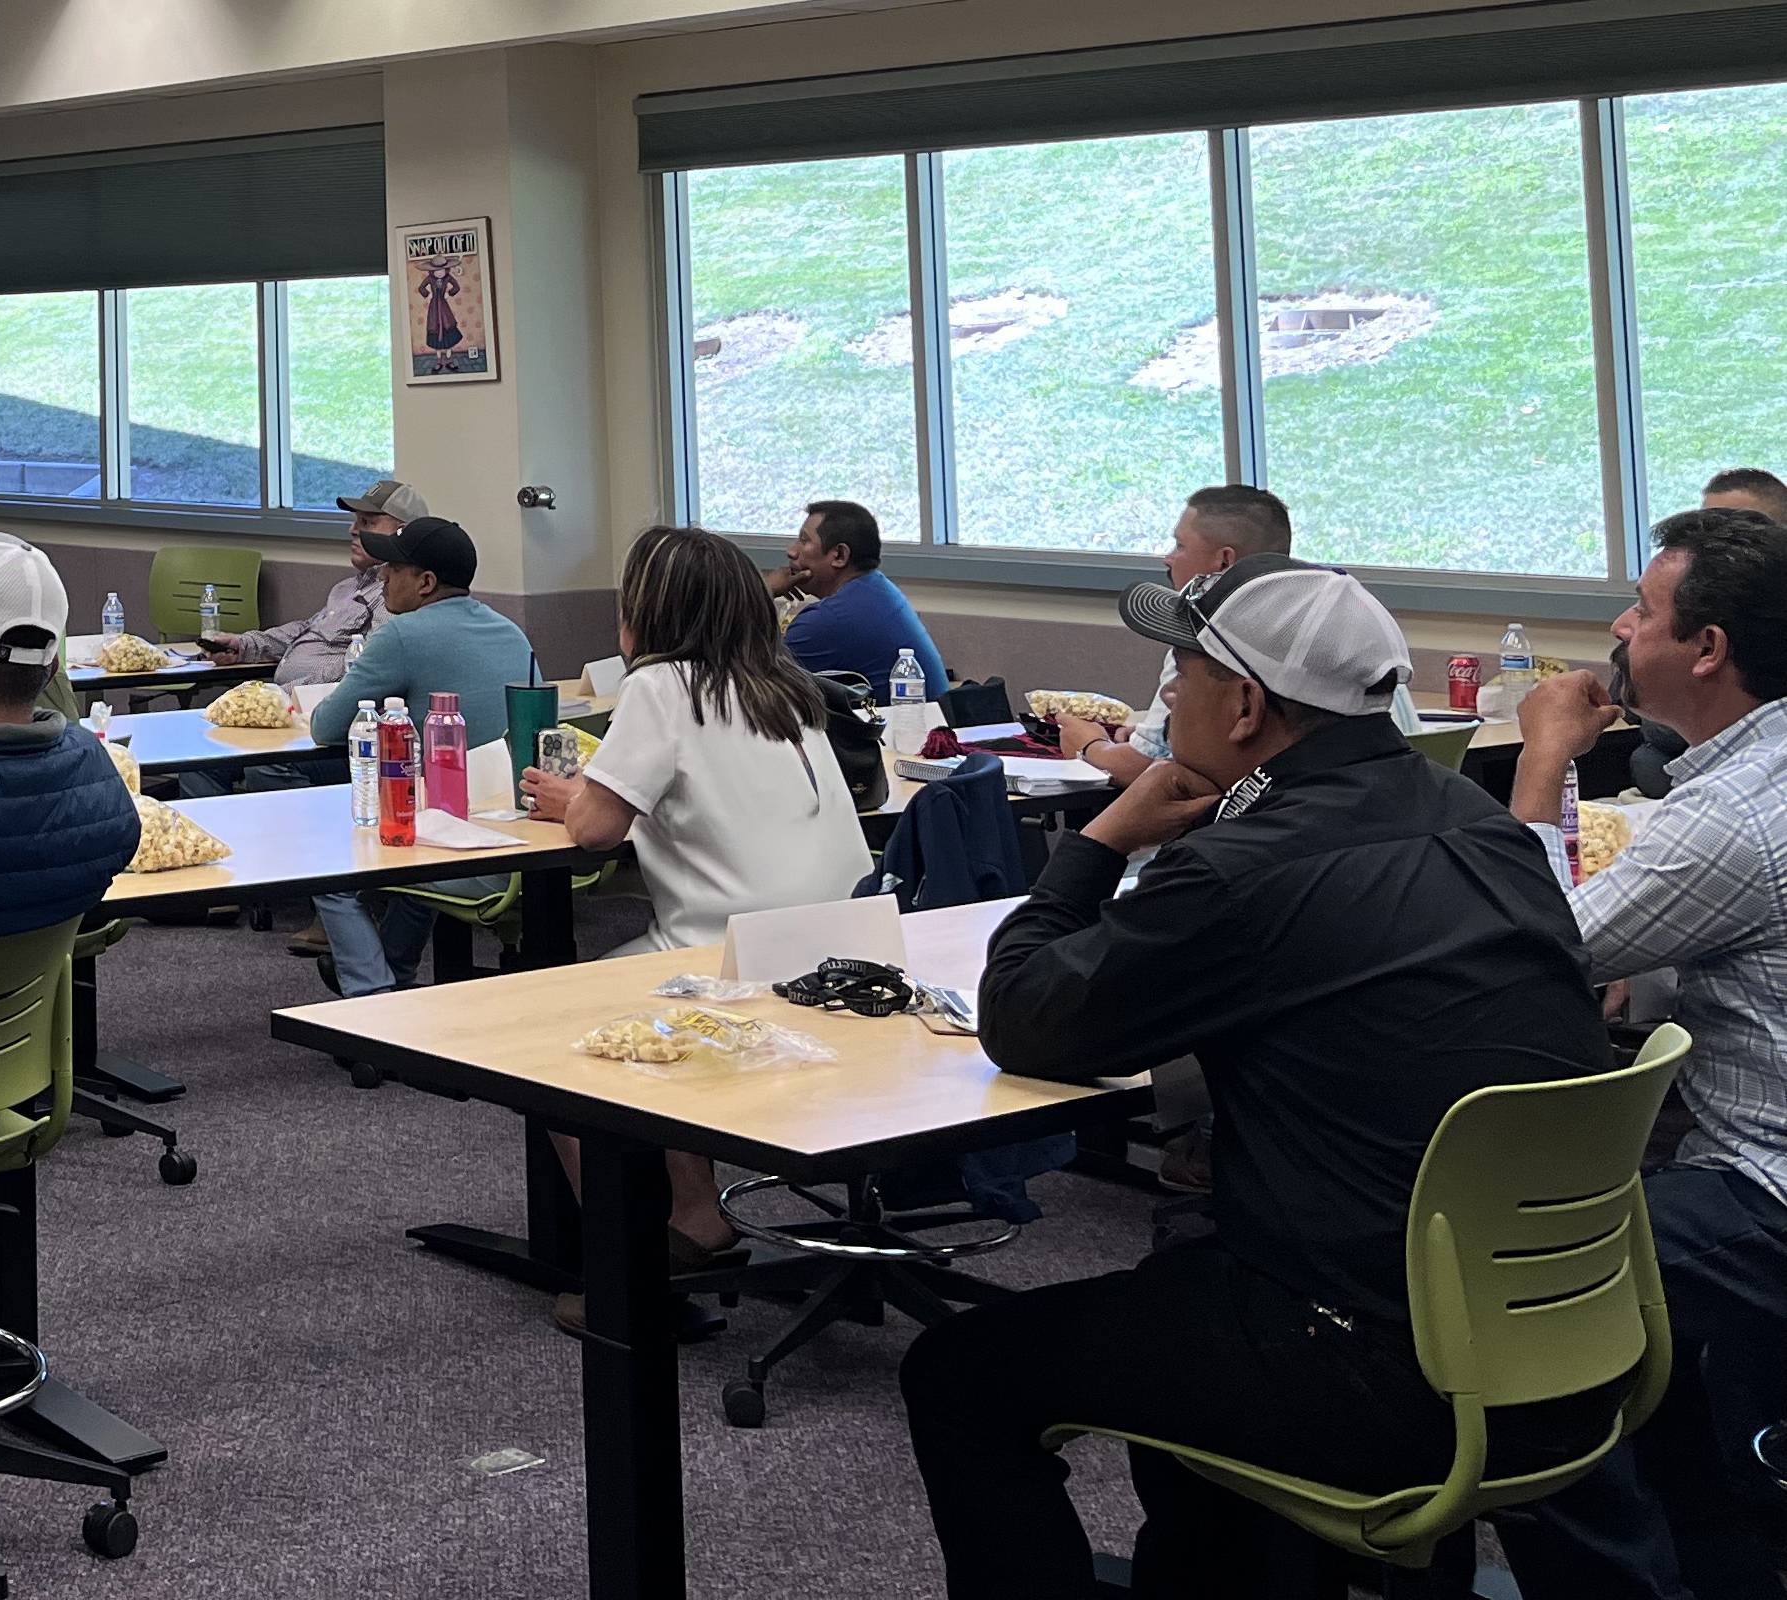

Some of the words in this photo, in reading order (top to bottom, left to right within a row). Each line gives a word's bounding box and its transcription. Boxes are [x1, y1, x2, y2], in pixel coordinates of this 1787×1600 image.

[408, 238, 433, 257] SNAP
[433, 236, 451, 255] OUT
[452, 234, 465, 253] OF
[465, 233, 476, 252] IT
